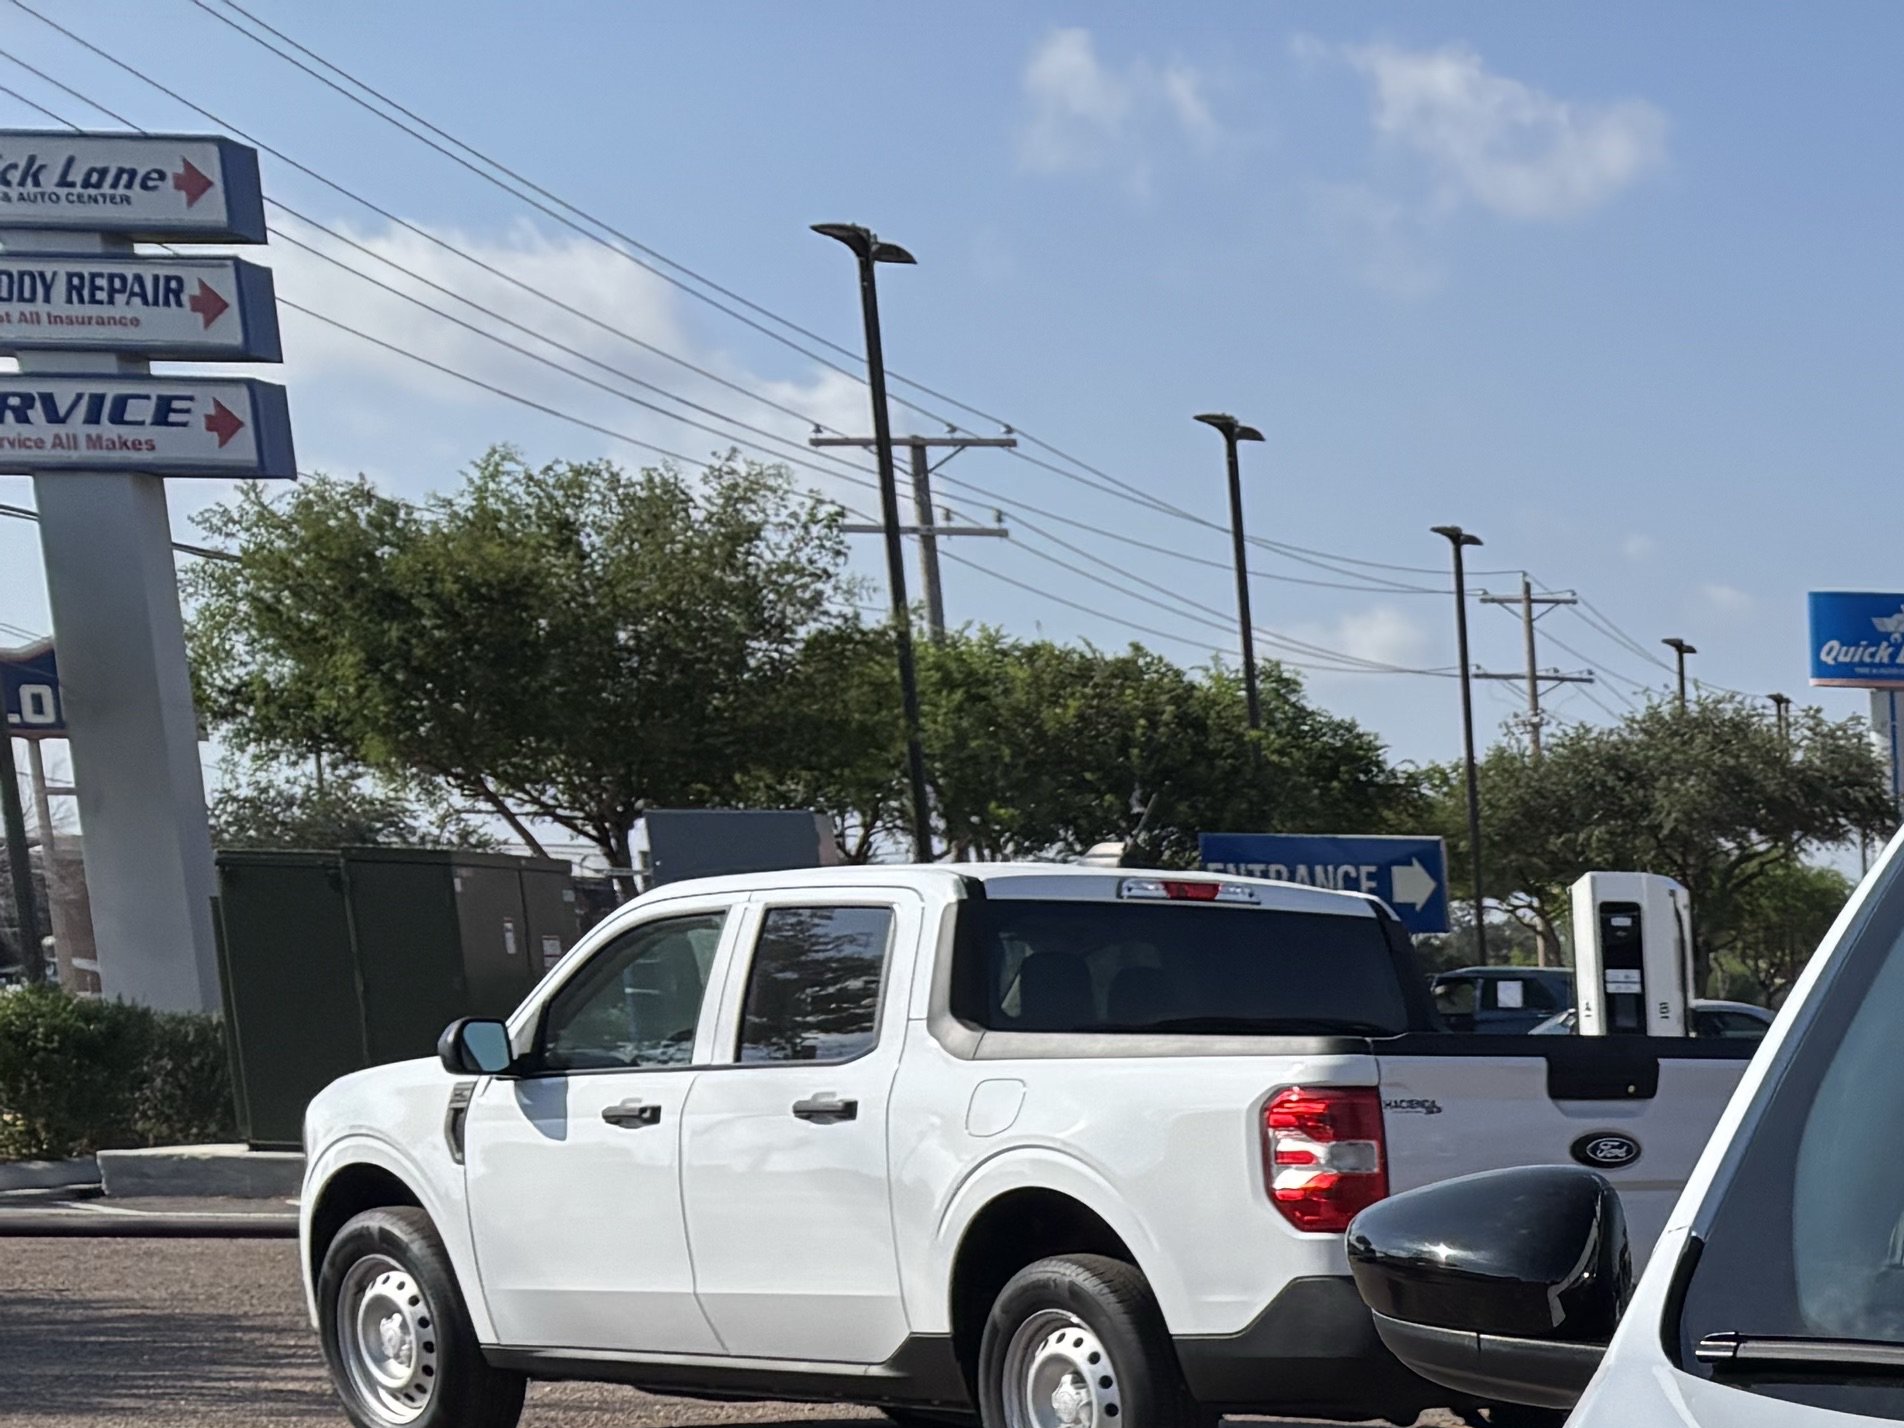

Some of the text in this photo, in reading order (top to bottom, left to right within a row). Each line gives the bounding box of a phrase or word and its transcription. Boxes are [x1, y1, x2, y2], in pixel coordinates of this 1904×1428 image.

[0, 153, 168, 192] ck Lane
[17, 191, 60, 204] AUTO
[65, 192, 132, 206] CENTER
[64, 271, 185, 308] REPAIR
[17, 311, 41, 325] All
[47, 311, 141, 328] Insurance
[51, 433, 78, 450] All
[85, 433, 156, 451] Makes
[1819, 639, 1895, 666] Quick
